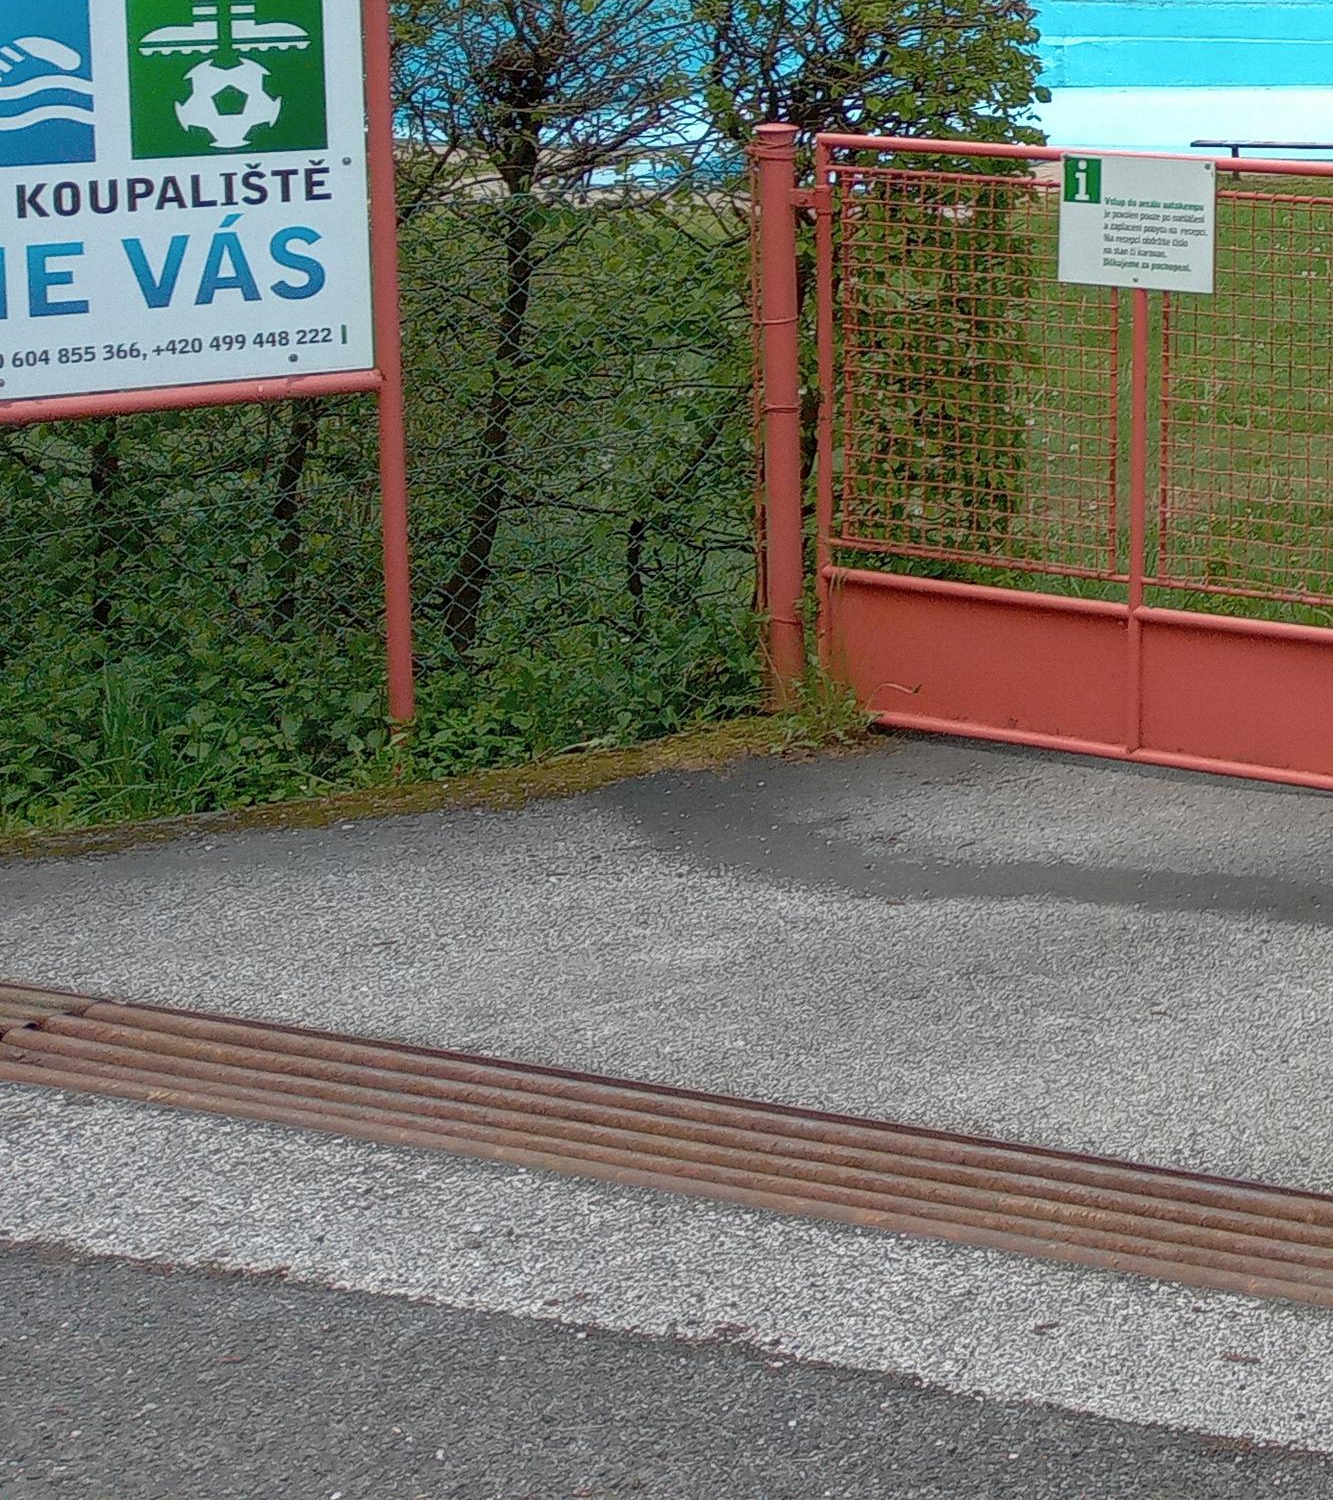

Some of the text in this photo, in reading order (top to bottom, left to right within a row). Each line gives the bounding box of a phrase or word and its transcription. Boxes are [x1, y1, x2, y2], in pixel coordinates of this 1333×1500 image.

[15, 158, 333, 219] KOUPALIŠTĚ
[0, 212, 326, 320] E VÁS
[12, 348, 51, 368] 604
[58, 345, 96, 364] 855
[102, 341, 148, 361] 366,
[152, 337, 203, 356] +420
[209, 333, 247, 351] 499
[252, 330, 290, 348] 448
[295, 327, 333, 345] 222
